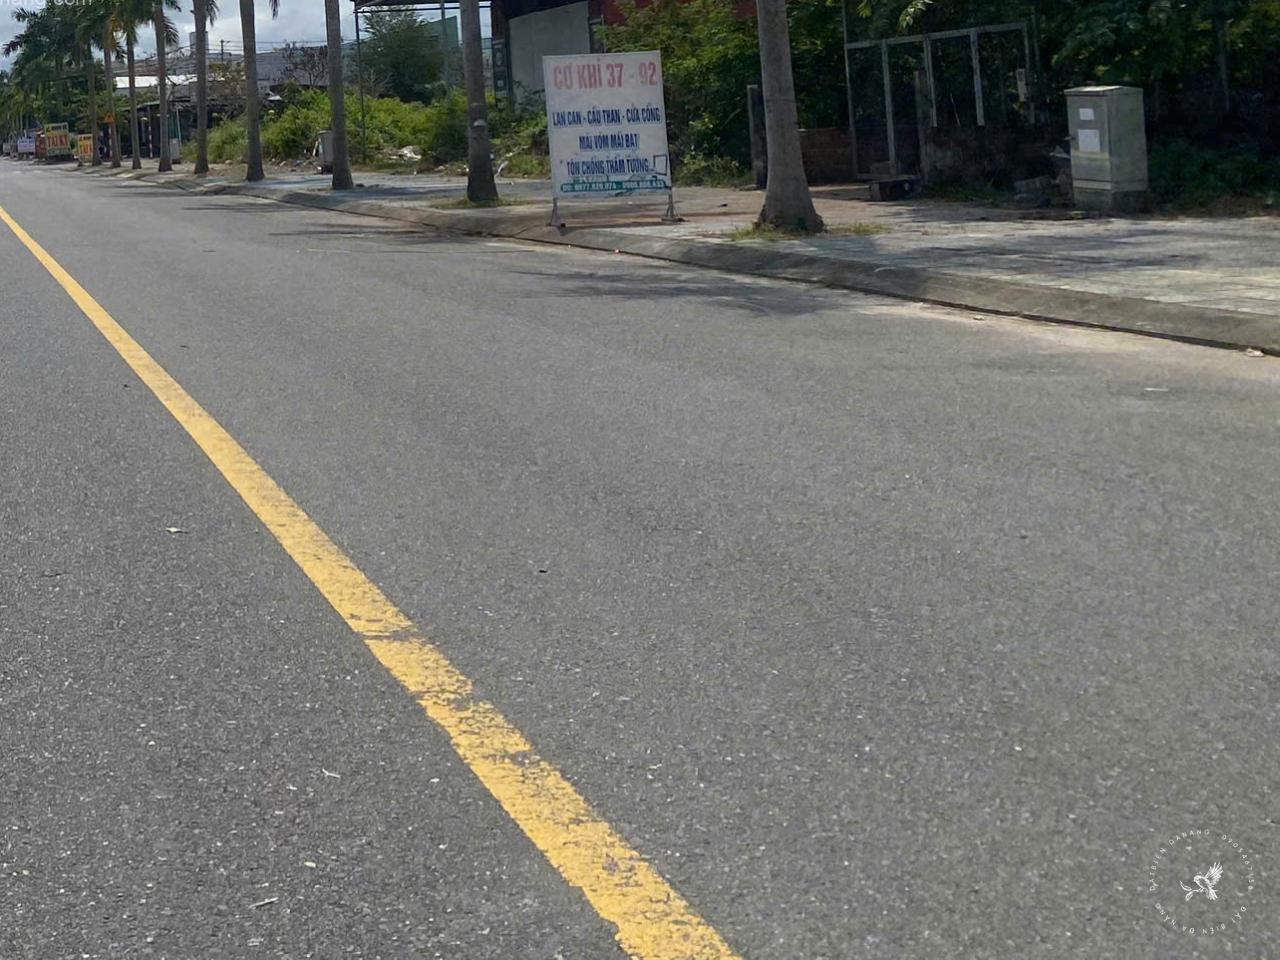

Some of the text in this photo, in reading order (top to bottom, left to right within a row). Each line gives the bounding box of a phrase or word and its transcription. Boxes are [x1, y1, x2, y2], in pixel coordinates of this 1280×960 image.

[553, 63, 573, 90] CƠ
[578, 57, 602, 89] KHÍ
[606, 63, 624, 88] 37
[639, 61, 658, 86] 92
[552, 111, 566, 126] LAN
[567, 111, 582, 125] CAN
